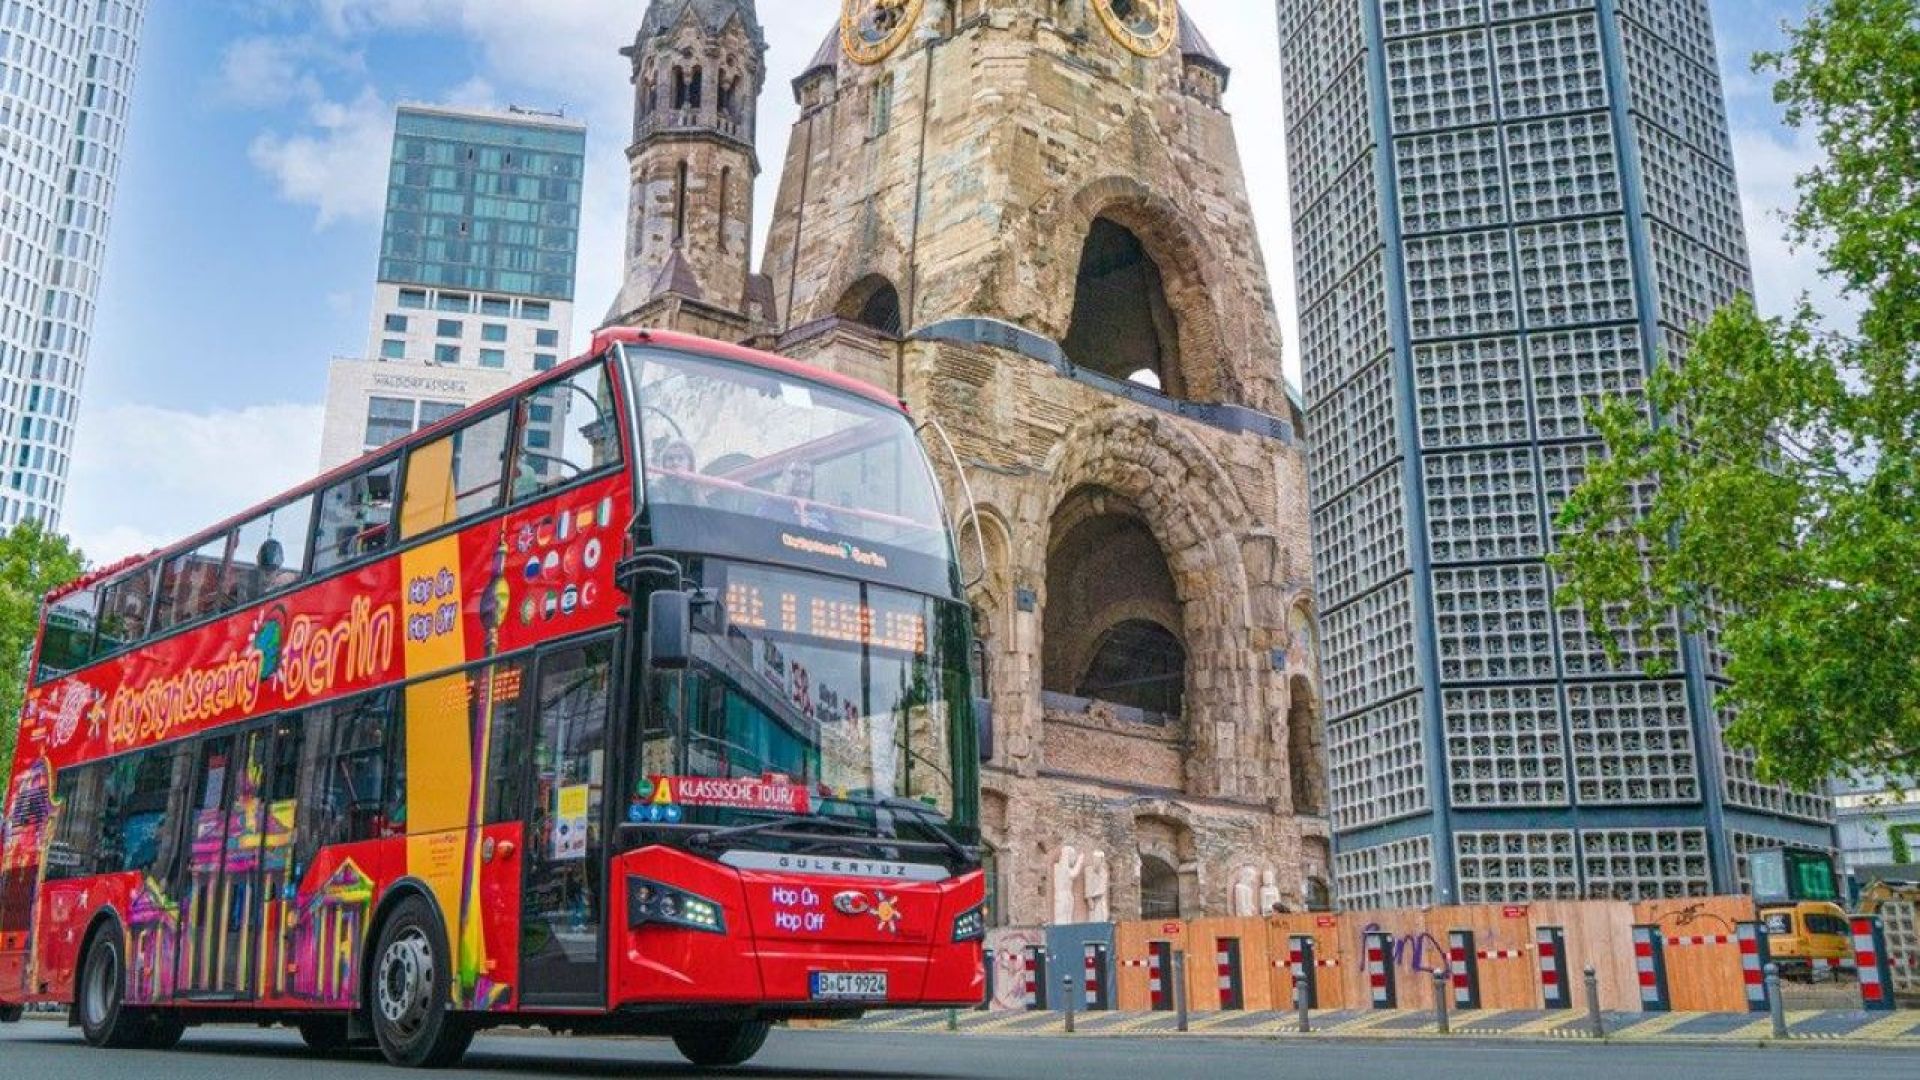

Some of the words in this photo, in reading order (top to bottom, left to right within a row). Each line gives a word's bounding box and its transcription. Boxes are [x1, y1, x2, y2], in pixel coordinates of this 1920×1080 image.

[408, 576, 434, 605] Hop
[434, 566, 455, 598] On
[408, 612, 433, 643] Hop
[434, 601, 458, 635] Off
[283, 595, 393, 700] Berlin
[678, 779, 753, 801] KLASSISCHE
[779, 856, 906, 875] GULERYUZ
[772, 886, 799, 906] Hop
[801, 887, 820, 906] On
[775, 911, 801, 931] Hop
[804, 912, 825, 931] Off
